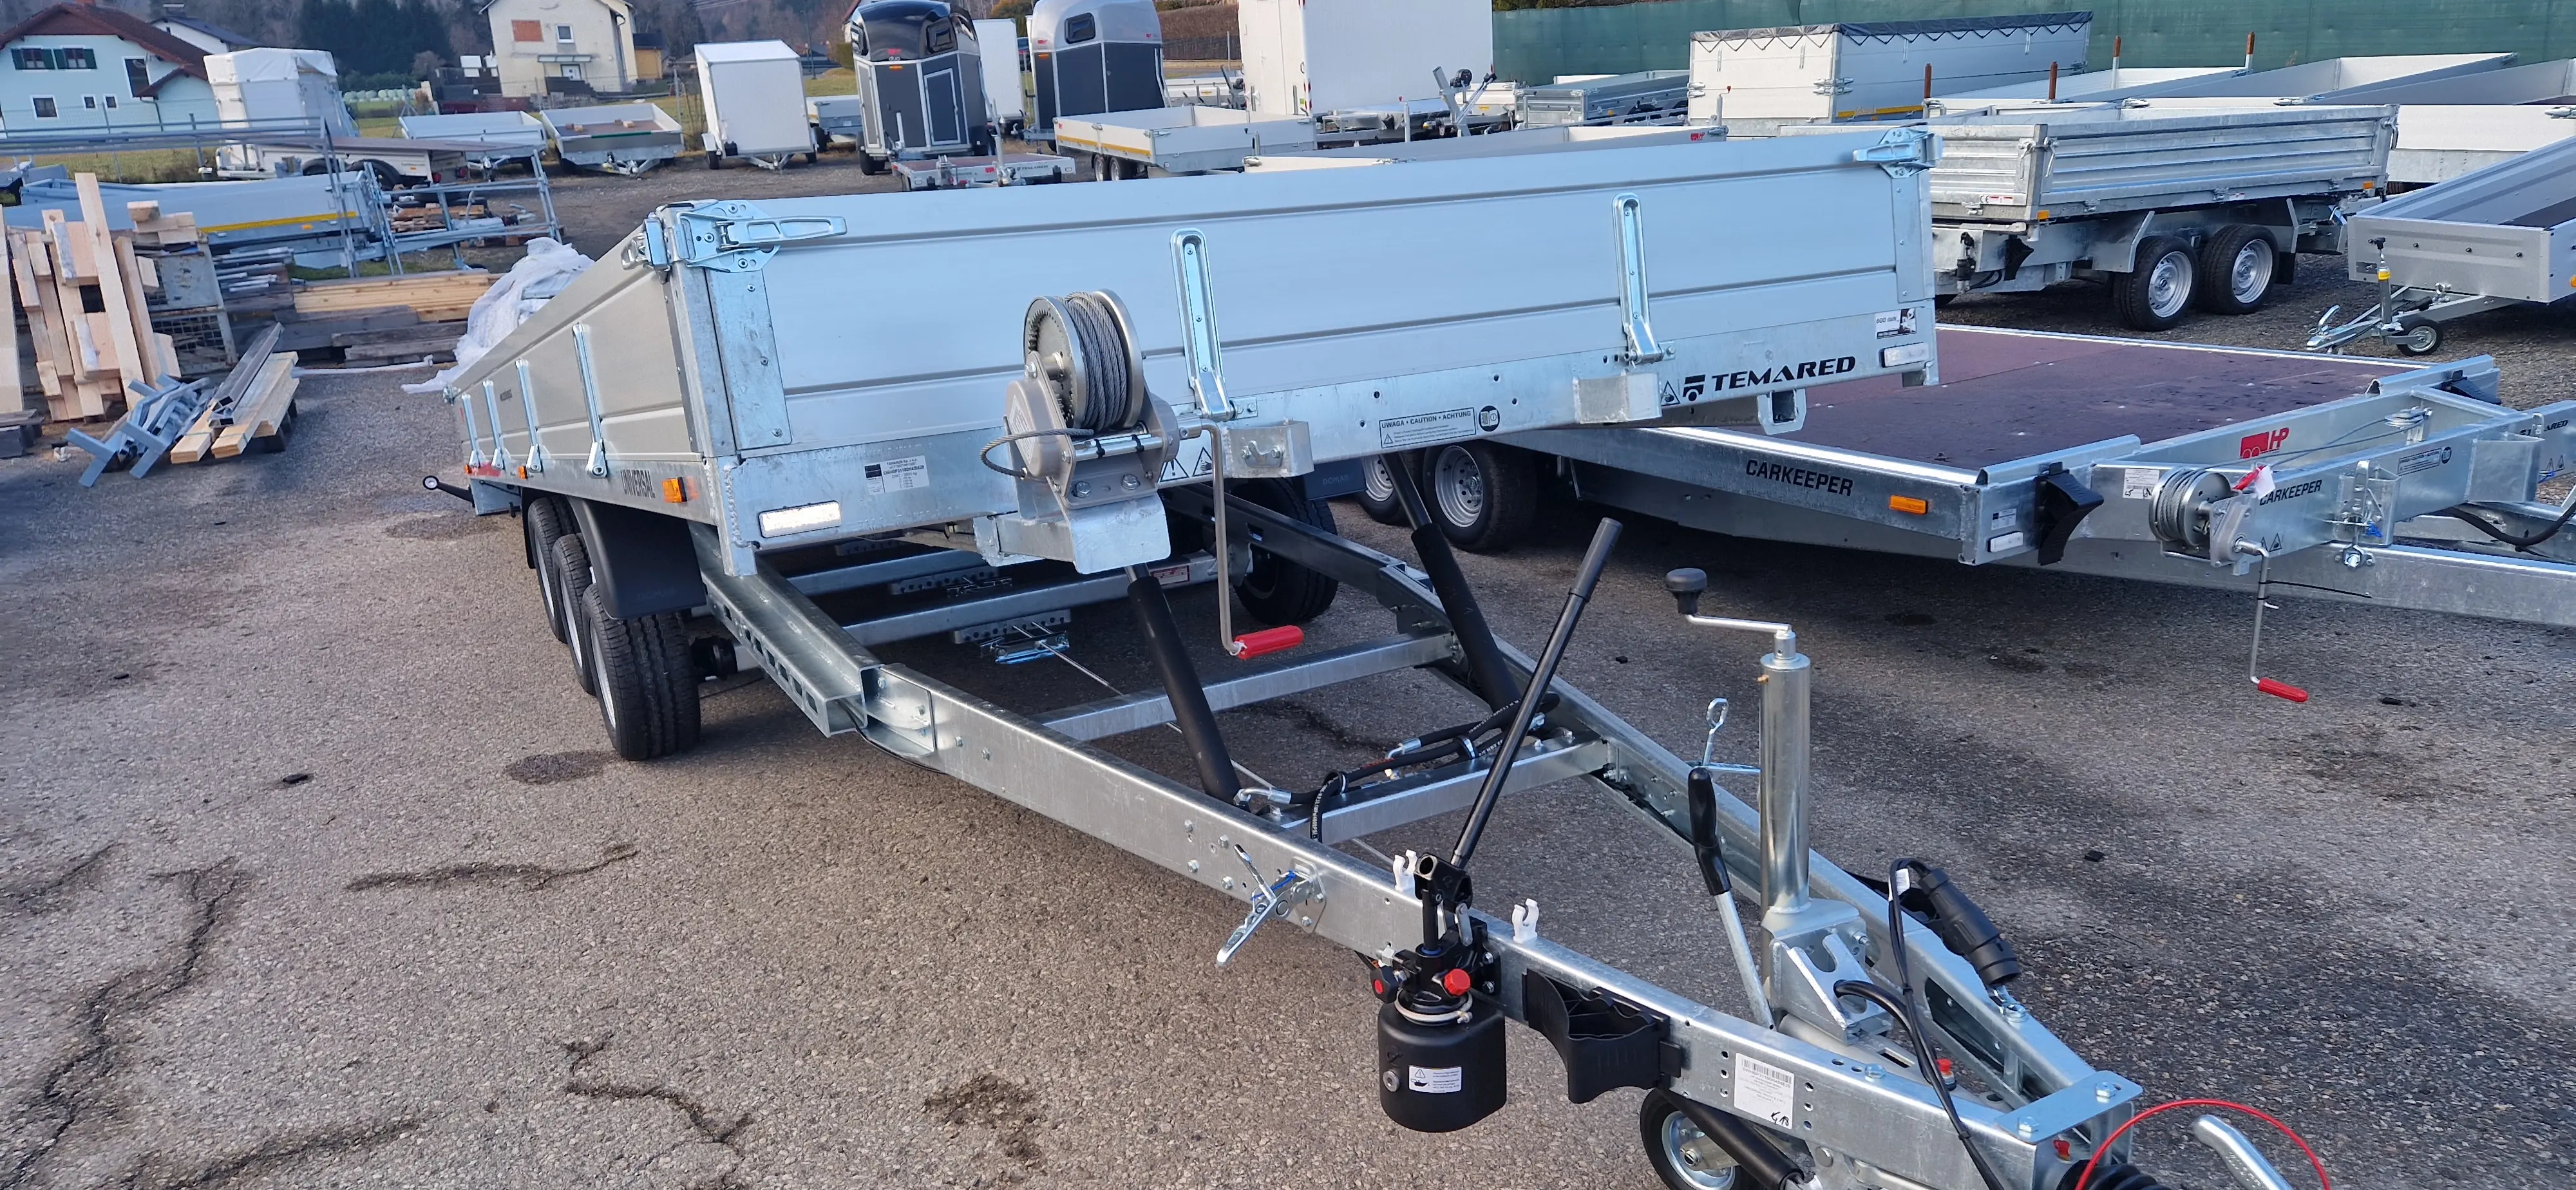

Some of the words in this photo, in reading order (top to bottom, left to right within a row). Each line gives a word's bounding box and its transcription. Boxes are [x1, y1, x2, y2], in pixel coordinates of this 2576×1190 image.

[1712, 355, 1855, 392] TEMARED
[1381, 420, 1405, 429] UWAGA
[1410, 415, 1437, 425] CAUTION
[1442, 410, 1472, 420] ACHTUNG
[2269, 427, 2289, 449] HP
[621, 469, 656, 498] UNIVERSAL
[1746, 459, 1853, 496] CARKEEPER
